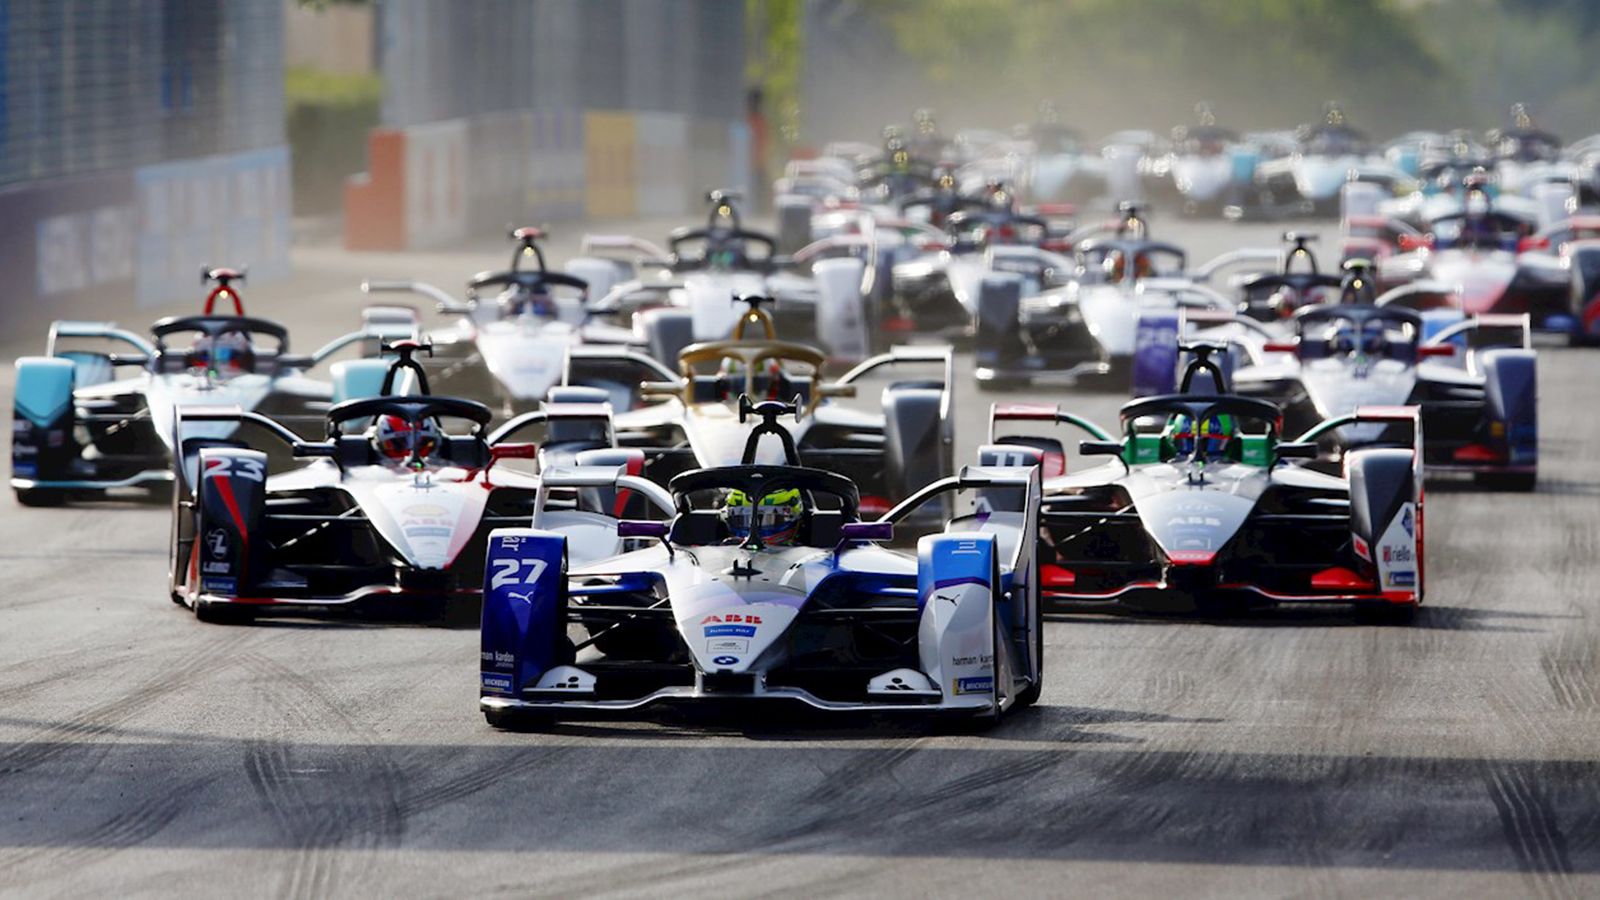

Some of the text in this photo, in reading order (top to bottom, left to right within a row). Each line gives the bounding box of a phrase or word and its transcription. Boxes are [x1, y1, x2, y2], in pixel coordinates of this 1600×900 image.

[203, 457, 264, 482] 23
[1168, 516, 1221, 526] ABB
[491, 559, 548, 591] 27
[700, 614, 762, 624] ABB
[952, 655, 977, 666] harman
